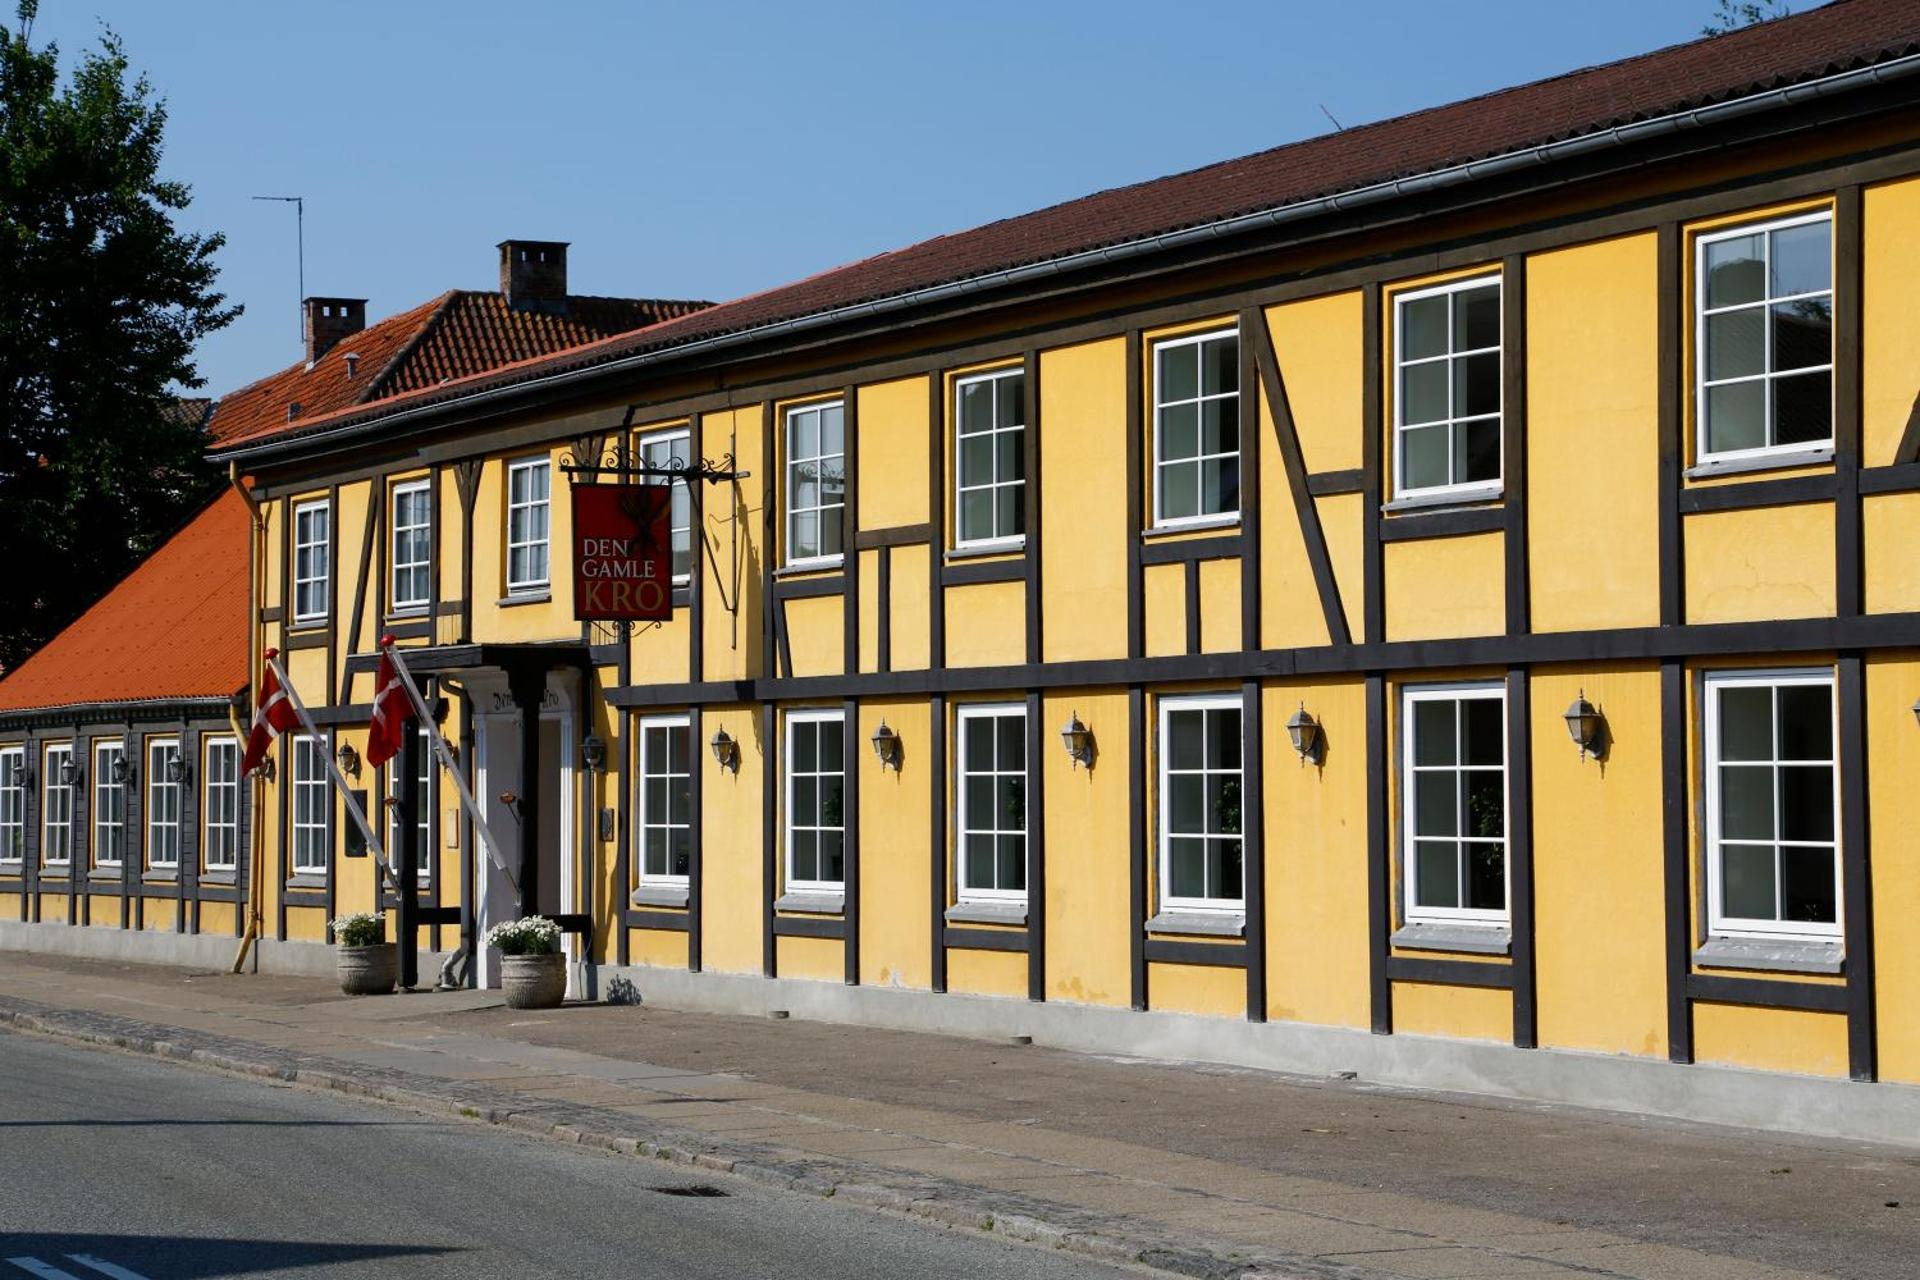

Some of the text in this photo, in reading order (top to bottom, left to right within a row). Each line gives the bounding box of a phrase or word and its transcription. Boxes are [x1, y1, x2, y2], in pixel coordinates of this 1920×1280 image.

[583, 538, 629, 557] DEN
[582, 559, 656, 578] GAMLE
[584, 580, 664, 612] KRO
